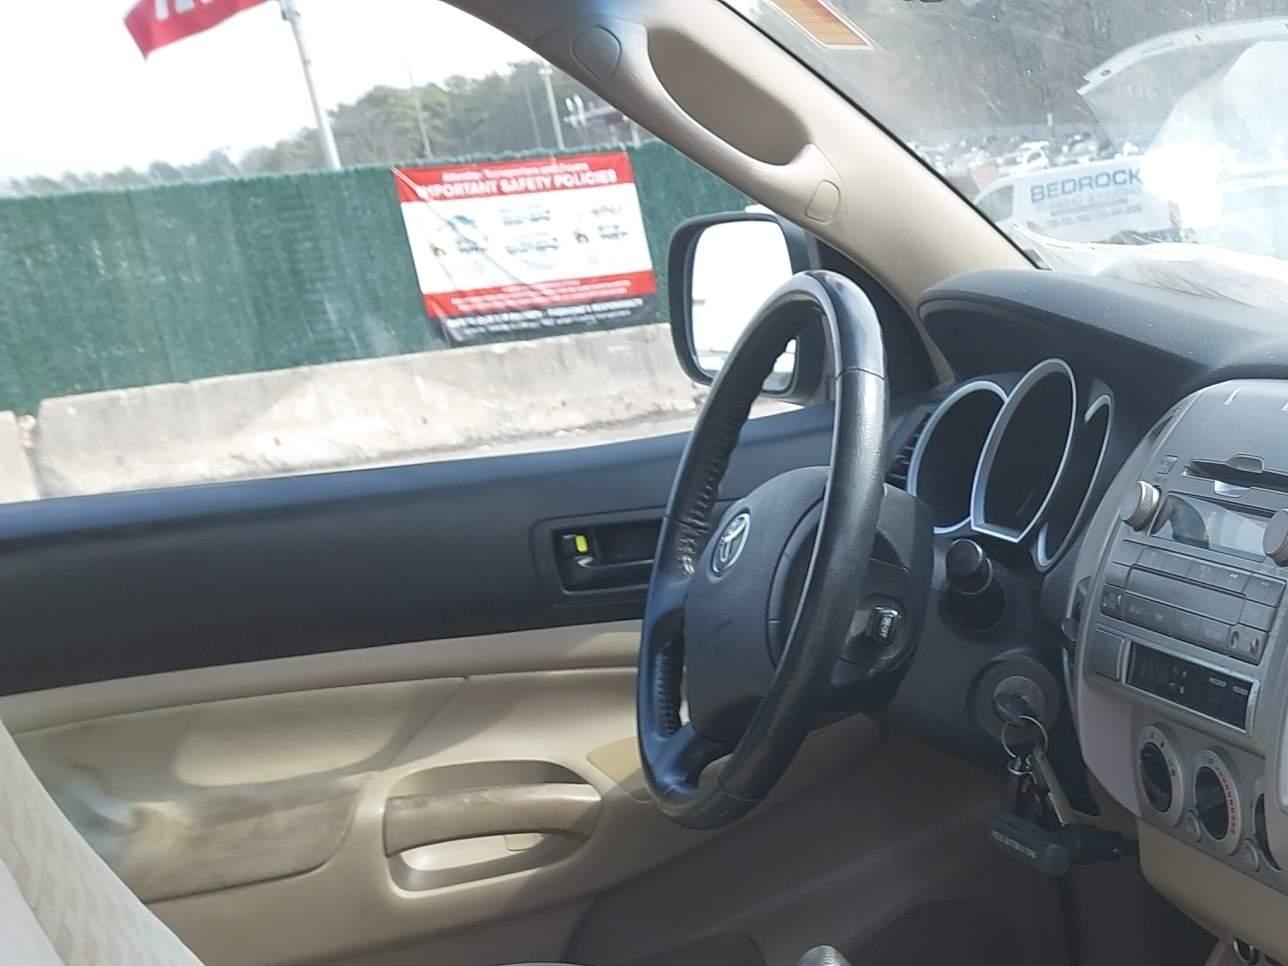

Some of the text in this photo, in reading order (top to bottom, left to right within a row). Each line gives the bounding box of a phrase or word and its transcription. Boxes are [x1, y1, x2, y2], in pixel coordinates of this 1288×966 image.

[500, 174, 553, 194] SAFETY
[553, 168, 618, 189] POLICIES
[1030, 167, 1143, 203] BEDROCK
